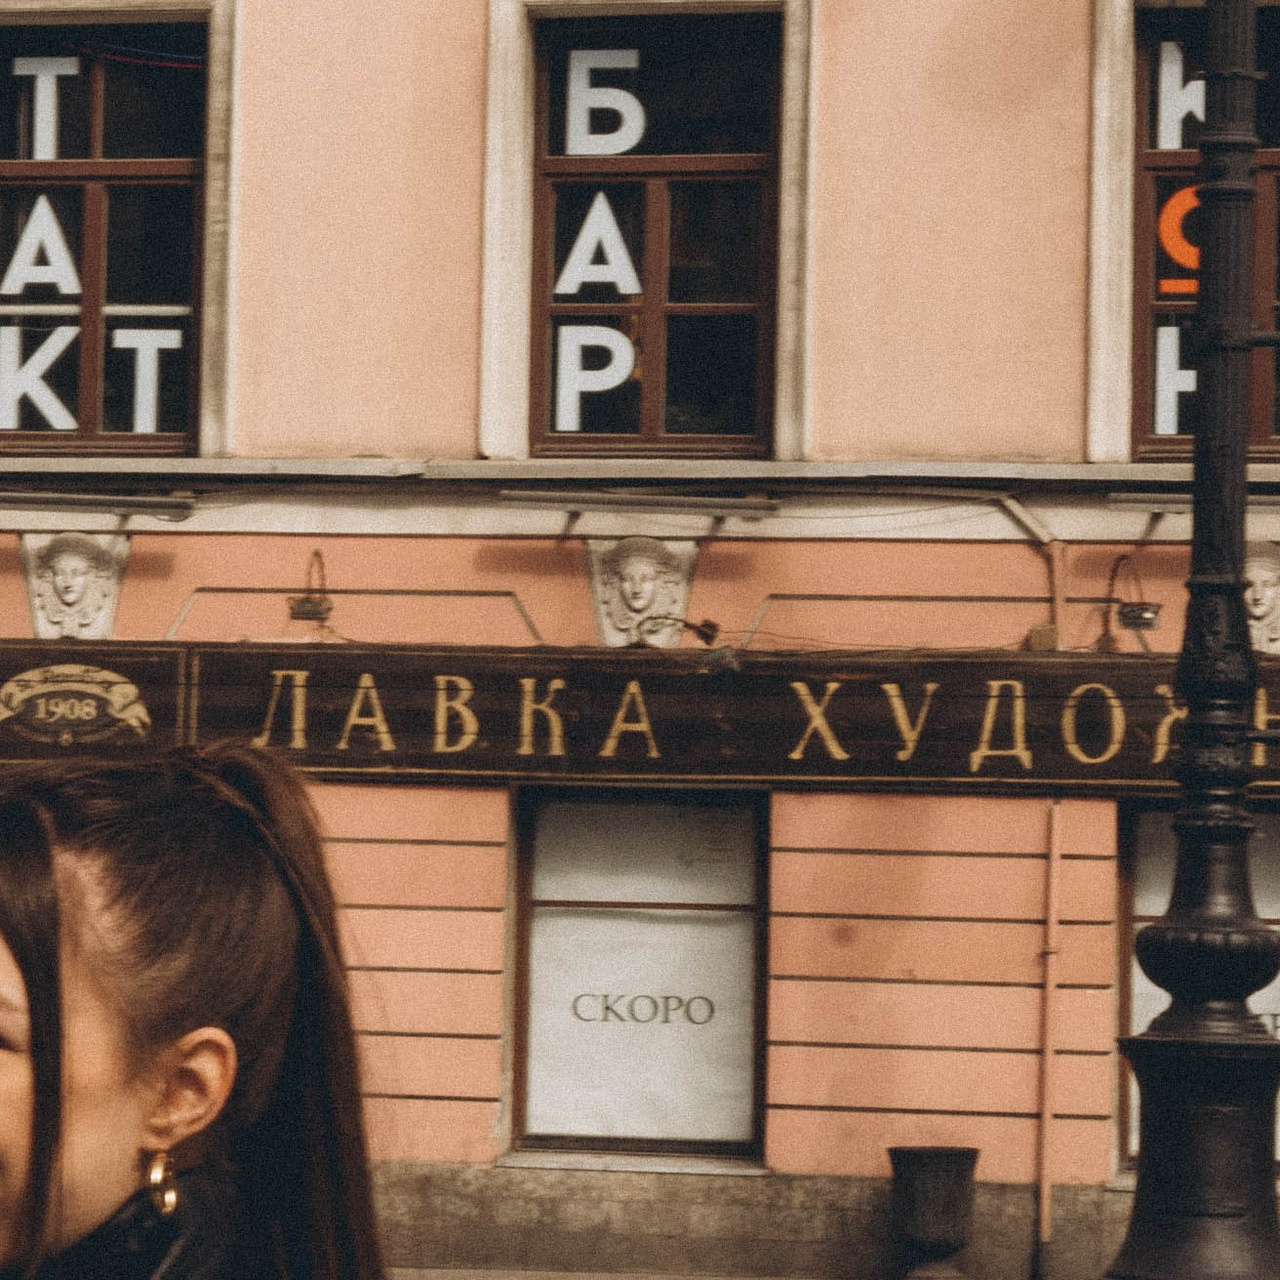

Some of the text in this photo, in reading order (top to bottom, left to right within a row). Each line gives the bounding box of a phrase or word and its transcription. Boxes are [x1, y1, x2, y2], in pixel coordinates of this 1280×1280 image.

[554, 48, 647, 432] БАР
[34, 698, 98, 722] 1908
[251, 669, 662, 759] ЛАВКА
[572, 993, 716, 1026] СКОРО
